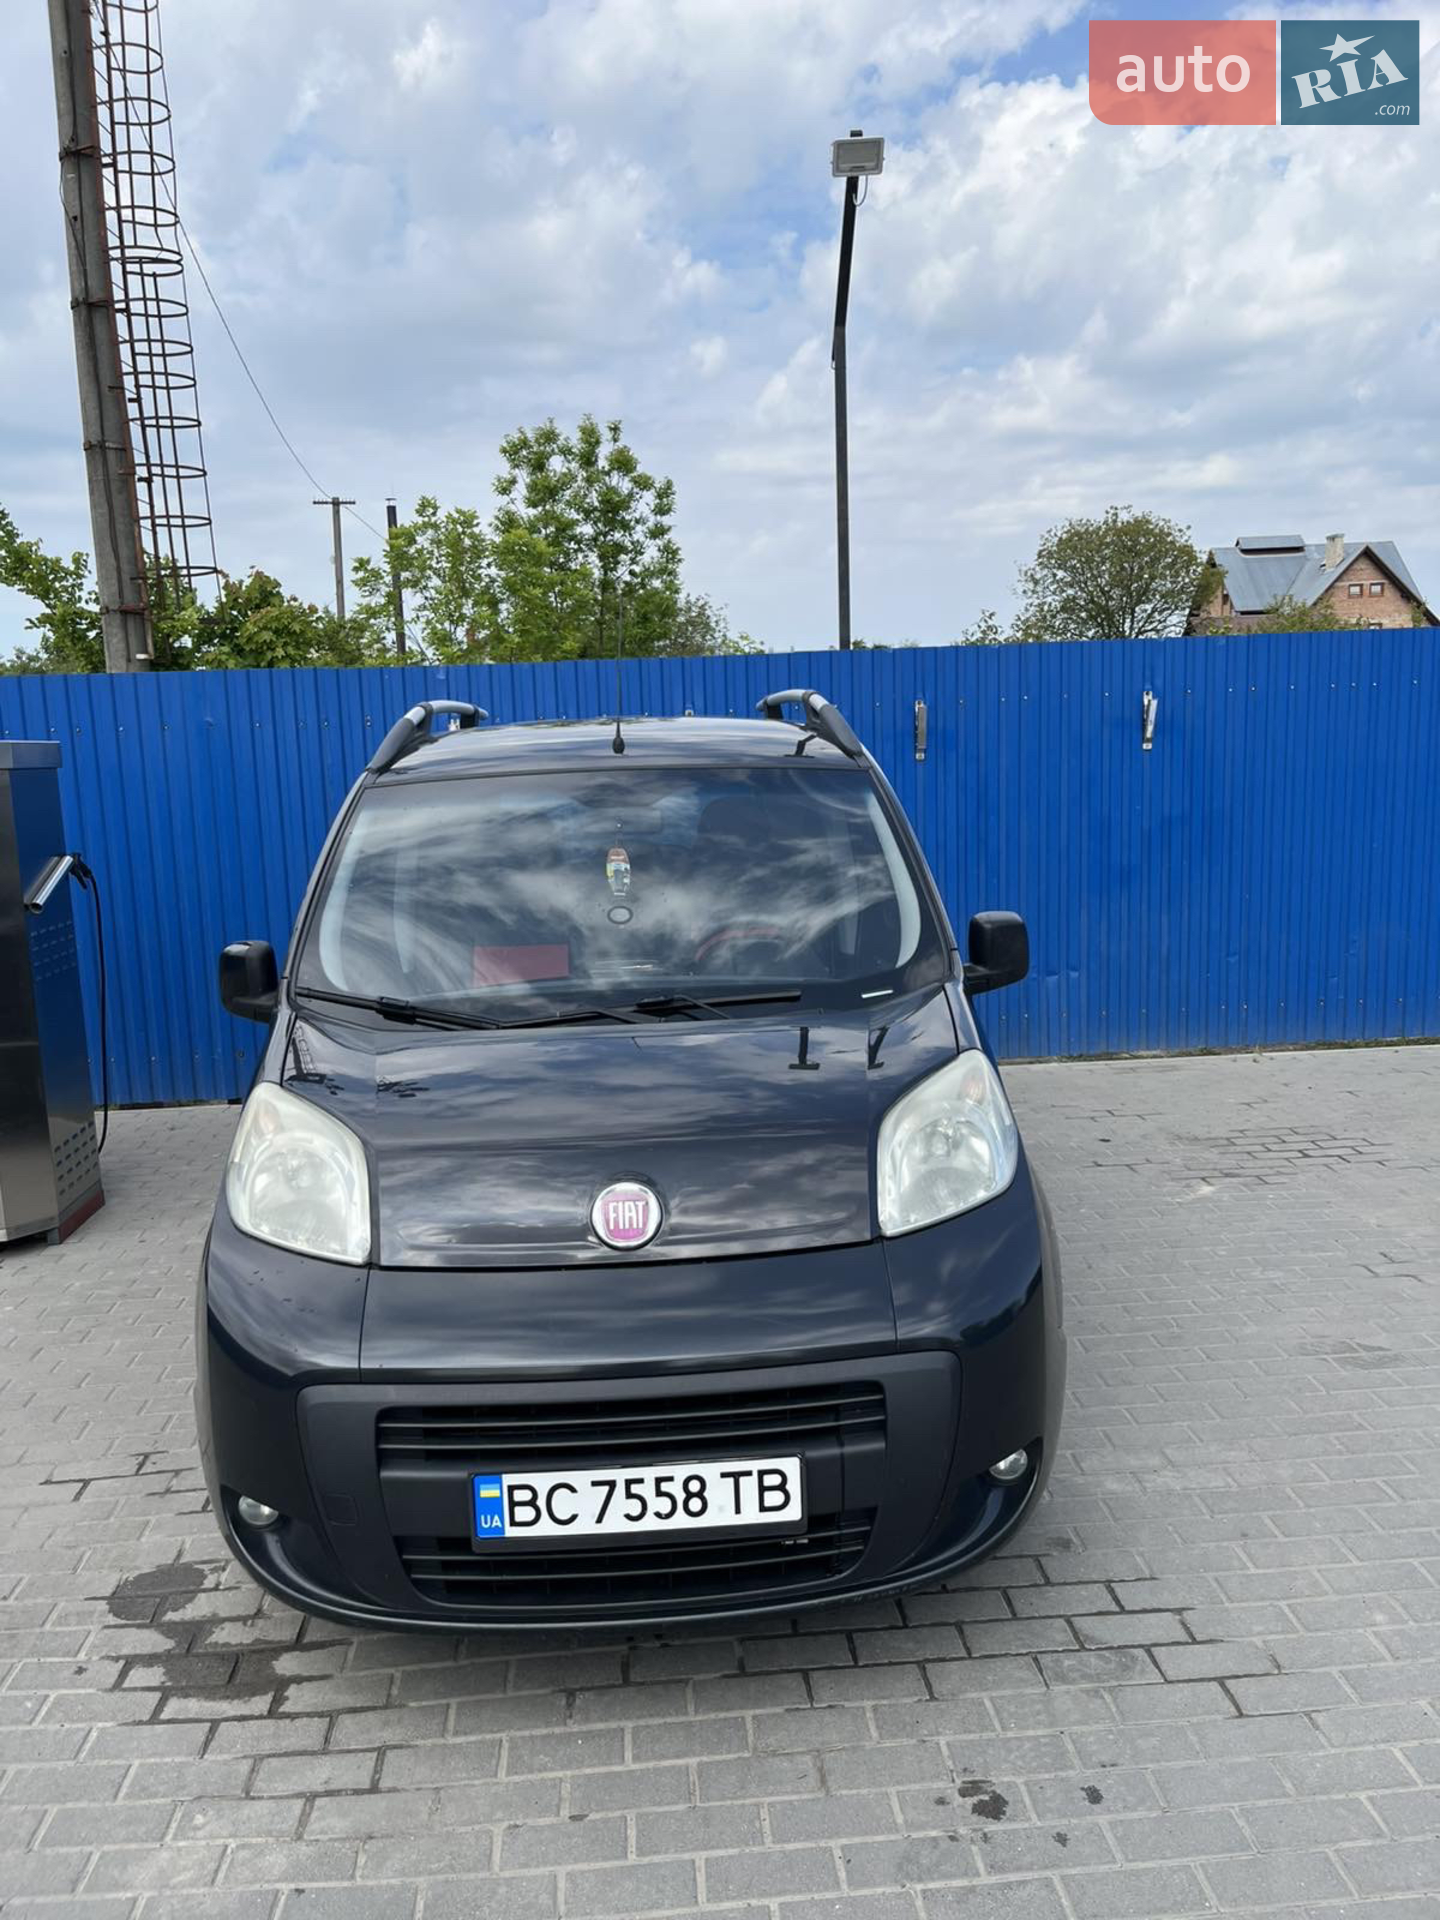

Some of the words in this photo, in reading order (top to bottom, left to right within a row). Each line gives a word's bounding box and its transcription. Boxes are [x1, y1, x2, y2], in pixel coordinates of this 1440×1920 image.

[608, 1201, 646, 1230] FIAT
[506, 1482, 579, 1528] BC
[590, 1474, 708, 1525] 7558
[719, 1468, 791, 1515] TB
[480, 1514, 502, 1528] UA
